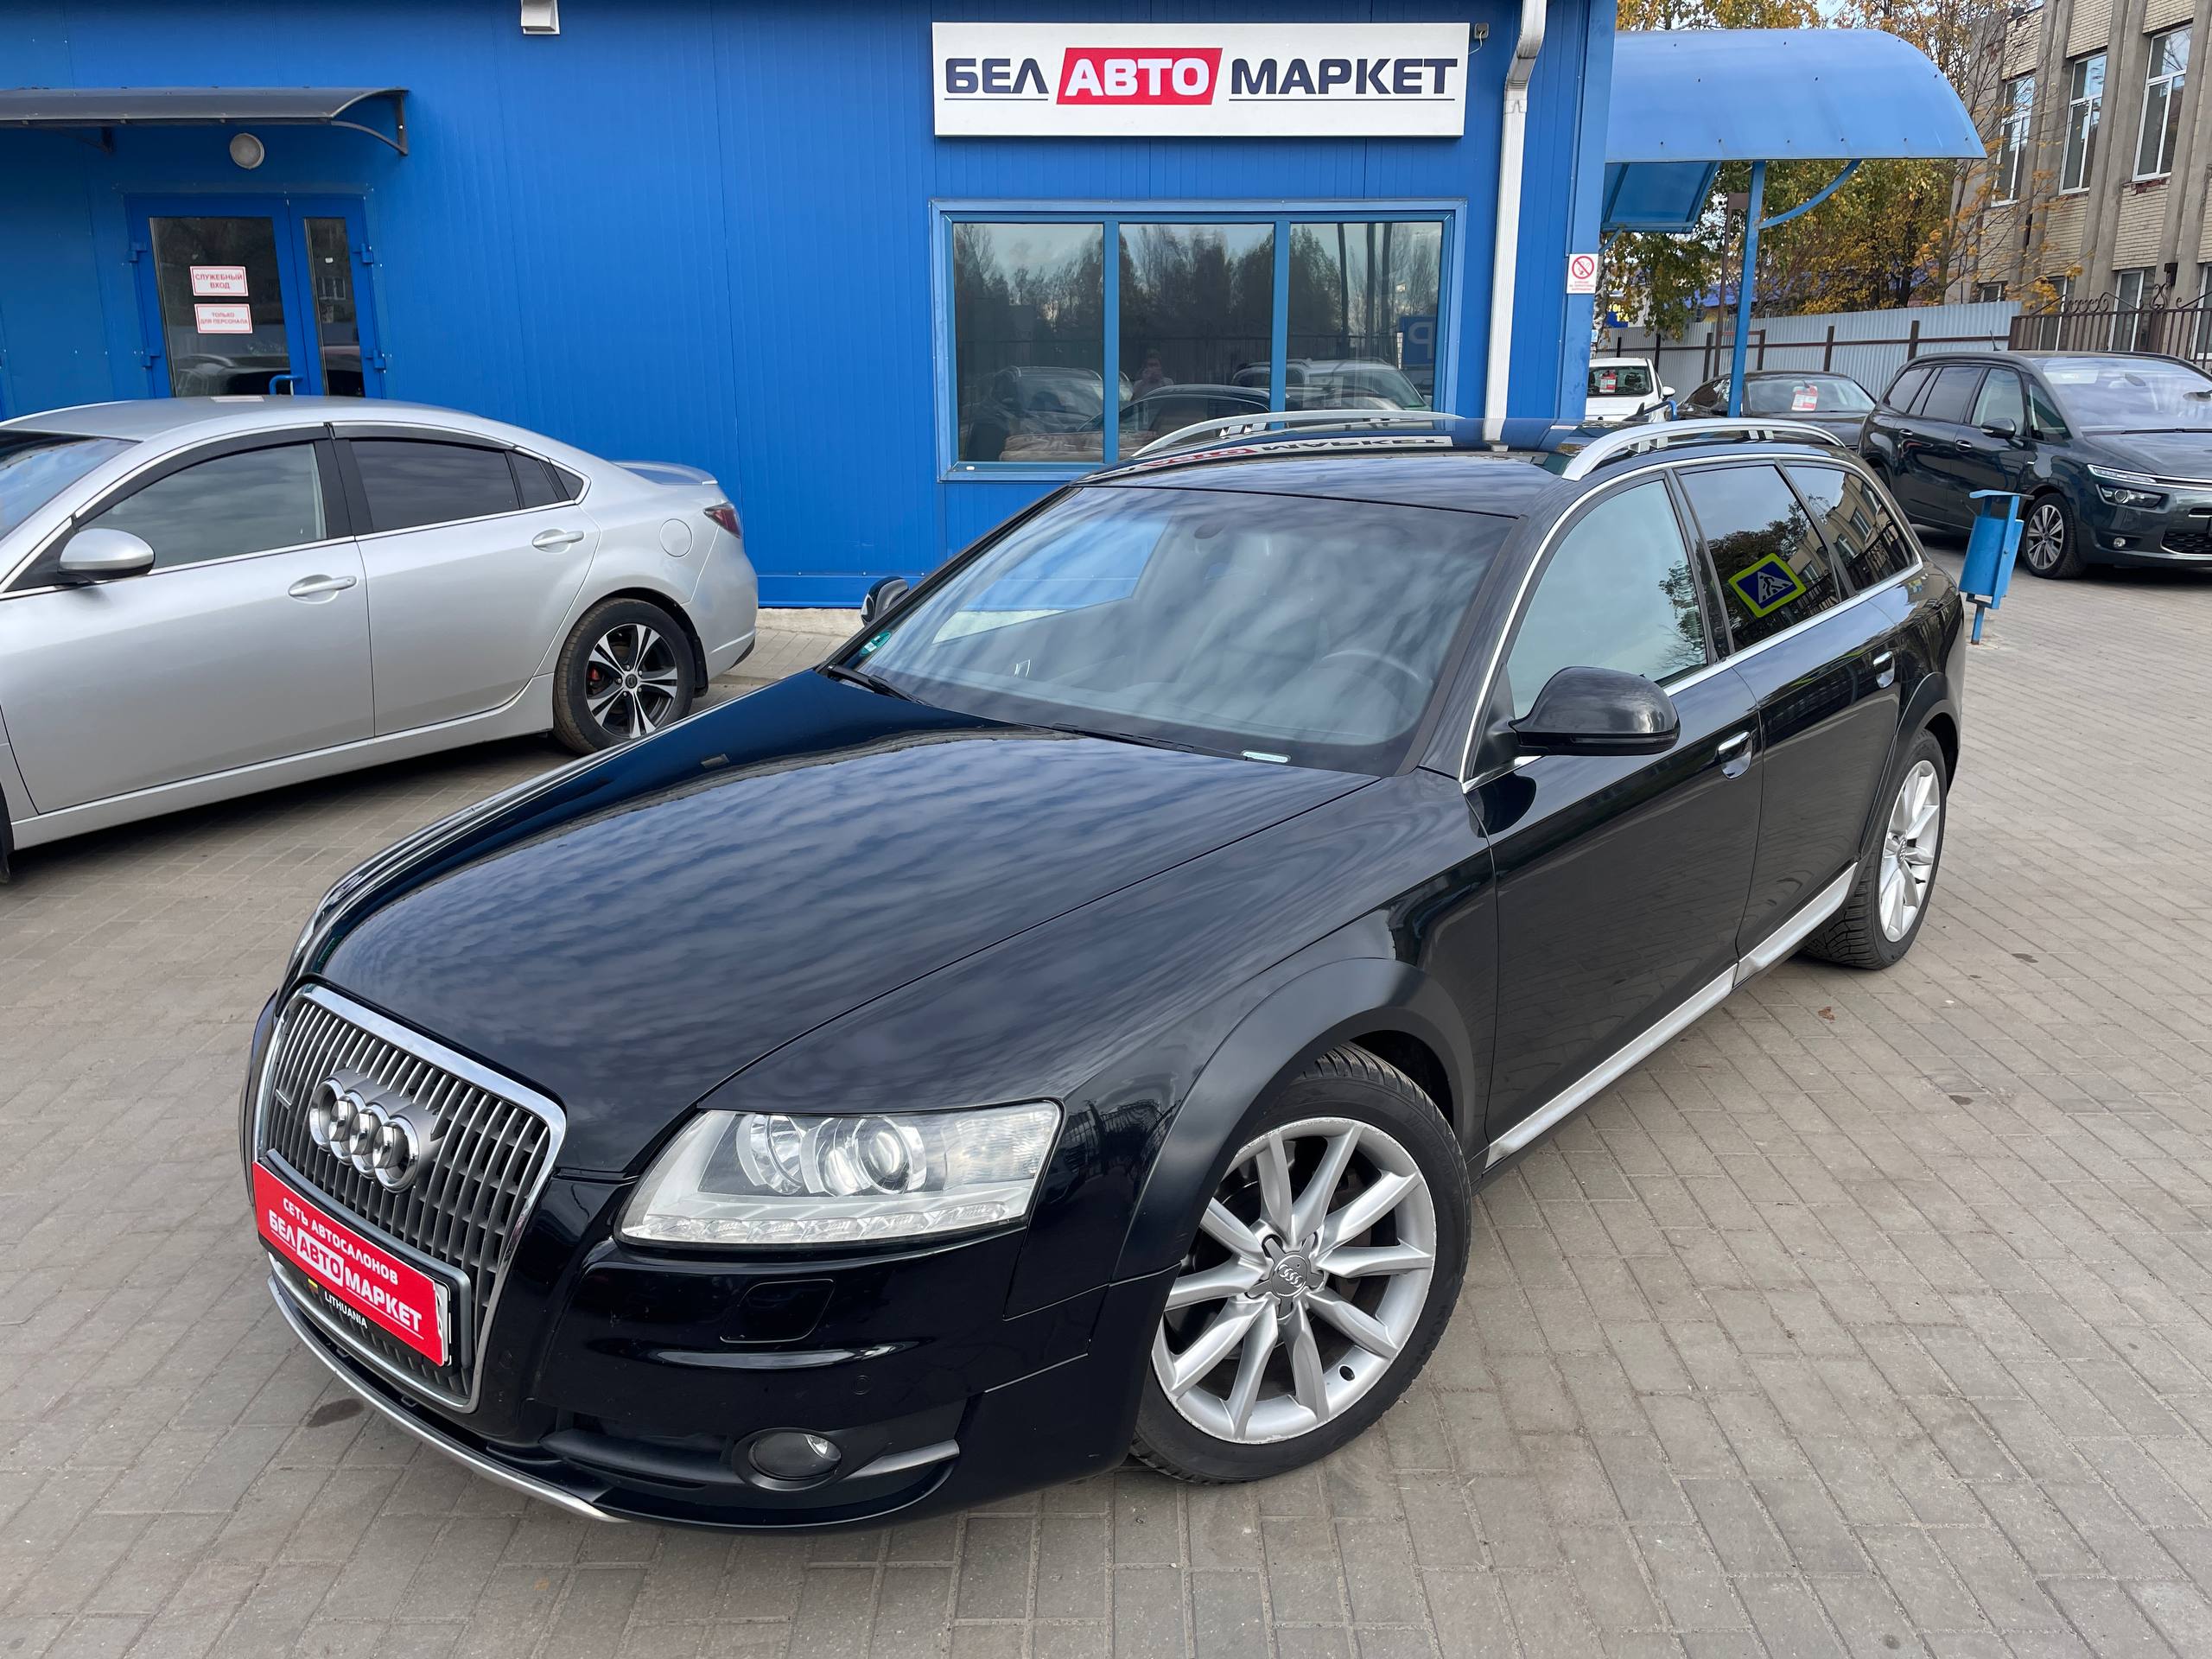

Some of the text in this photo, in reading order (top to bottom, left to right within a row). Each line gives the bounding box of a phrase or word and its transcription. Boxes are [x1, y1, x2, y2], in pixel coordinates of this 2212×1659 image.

[945, 57, 1458, 96] БЕЛ АВТО МАРКЕТ
[194, 272, 243, 281] СЛУЖЕБНЫЙ
[283, 1198, 399, 1286] СЕТЬ АВТОСАЛОНОВ
[269, 1209, 423, 1332] БЕЛ АВТО МАРКЕТ
[324, 1290, 368, 1329] LITHUANIA
